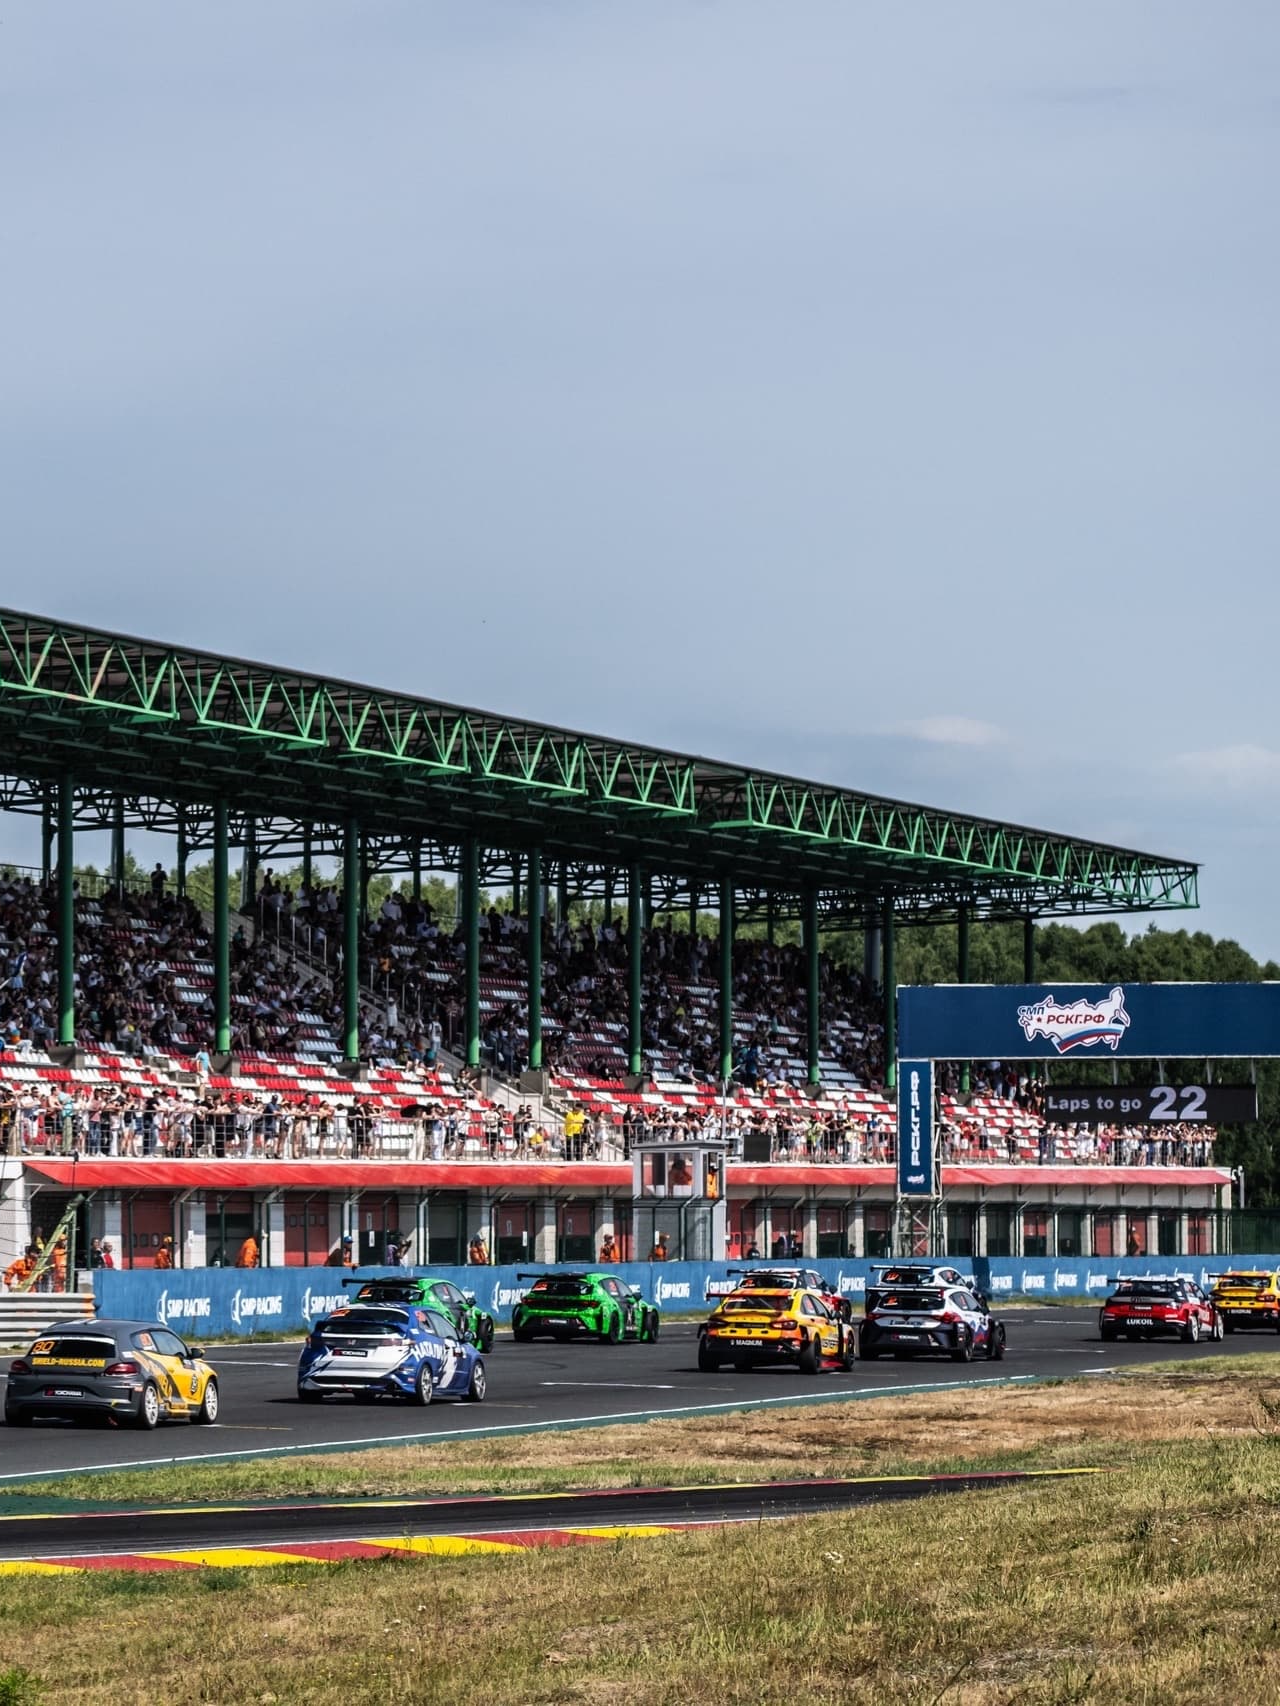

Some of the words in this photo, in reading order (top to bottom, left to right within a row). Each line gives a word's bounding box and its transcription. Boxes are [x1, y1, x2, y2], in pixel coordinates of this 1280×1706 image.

[1046, 1014, 1105, 1025] РСКГ.РФ
[1048, 1096, 1091, 1112] Laps
[1097, 1096, 1114, 1110] to
[1120, 1098, 1142, 1112] go
[1149, 1085, 1208, 1120] 22
[910, 1070, 921, 1167] РСКГ.РФ
[167, 1299, 183, 1318] SMP
[184, 1297, 211, 1317] RACING
[1126, 1318, 1154, 1326] LUKOIL
[32, 1341, 56, 1352] 80
